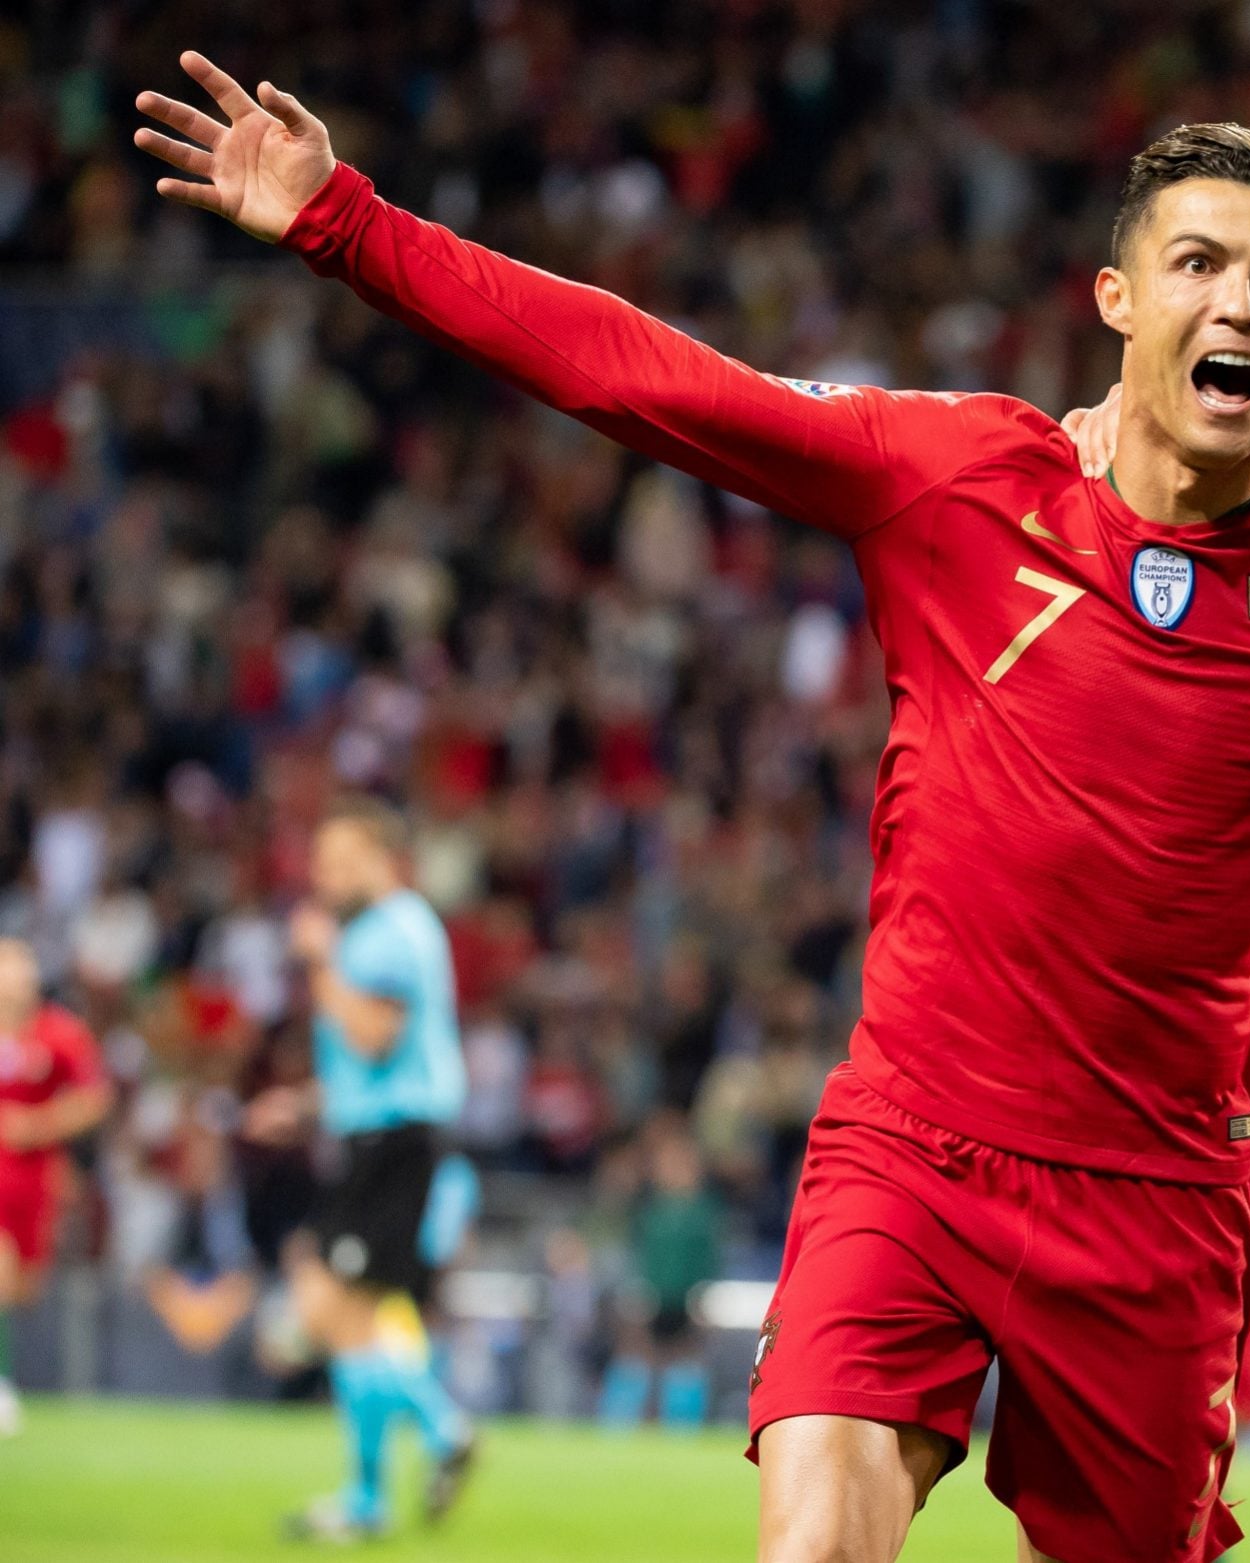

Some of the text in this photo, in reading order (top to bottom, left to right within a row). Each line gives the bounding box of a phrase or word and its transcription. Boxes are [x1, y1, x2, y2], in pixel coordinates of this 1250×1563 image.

[1151, 551, 1176, 562] UEFA
[1139, 564, 1188, 574] EUROPEAN
[1139, 572, 1187, 583] CHAMPIONS
[982, 565, 1088, 685] 7
